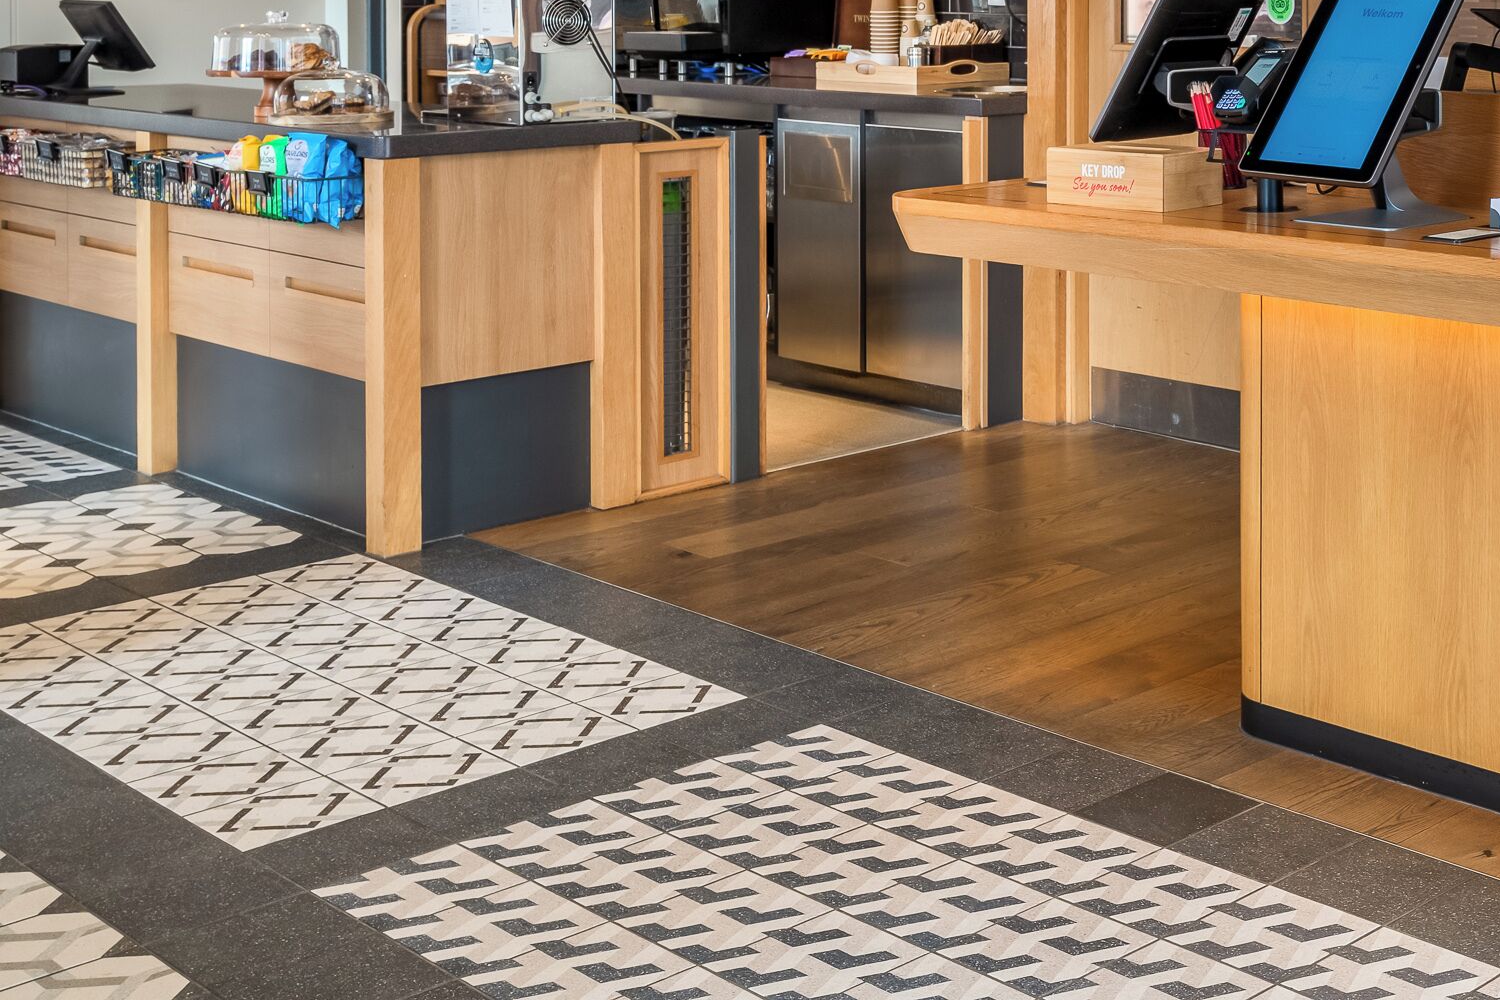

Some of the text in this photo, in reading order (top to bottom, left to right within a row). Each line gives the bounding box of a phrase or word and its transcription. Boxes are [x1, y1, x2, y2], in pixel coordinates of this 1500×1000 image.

[1081, 163, 1126, 179] KEY DROP
[1072, 176, 1135, 197] See you soon!
